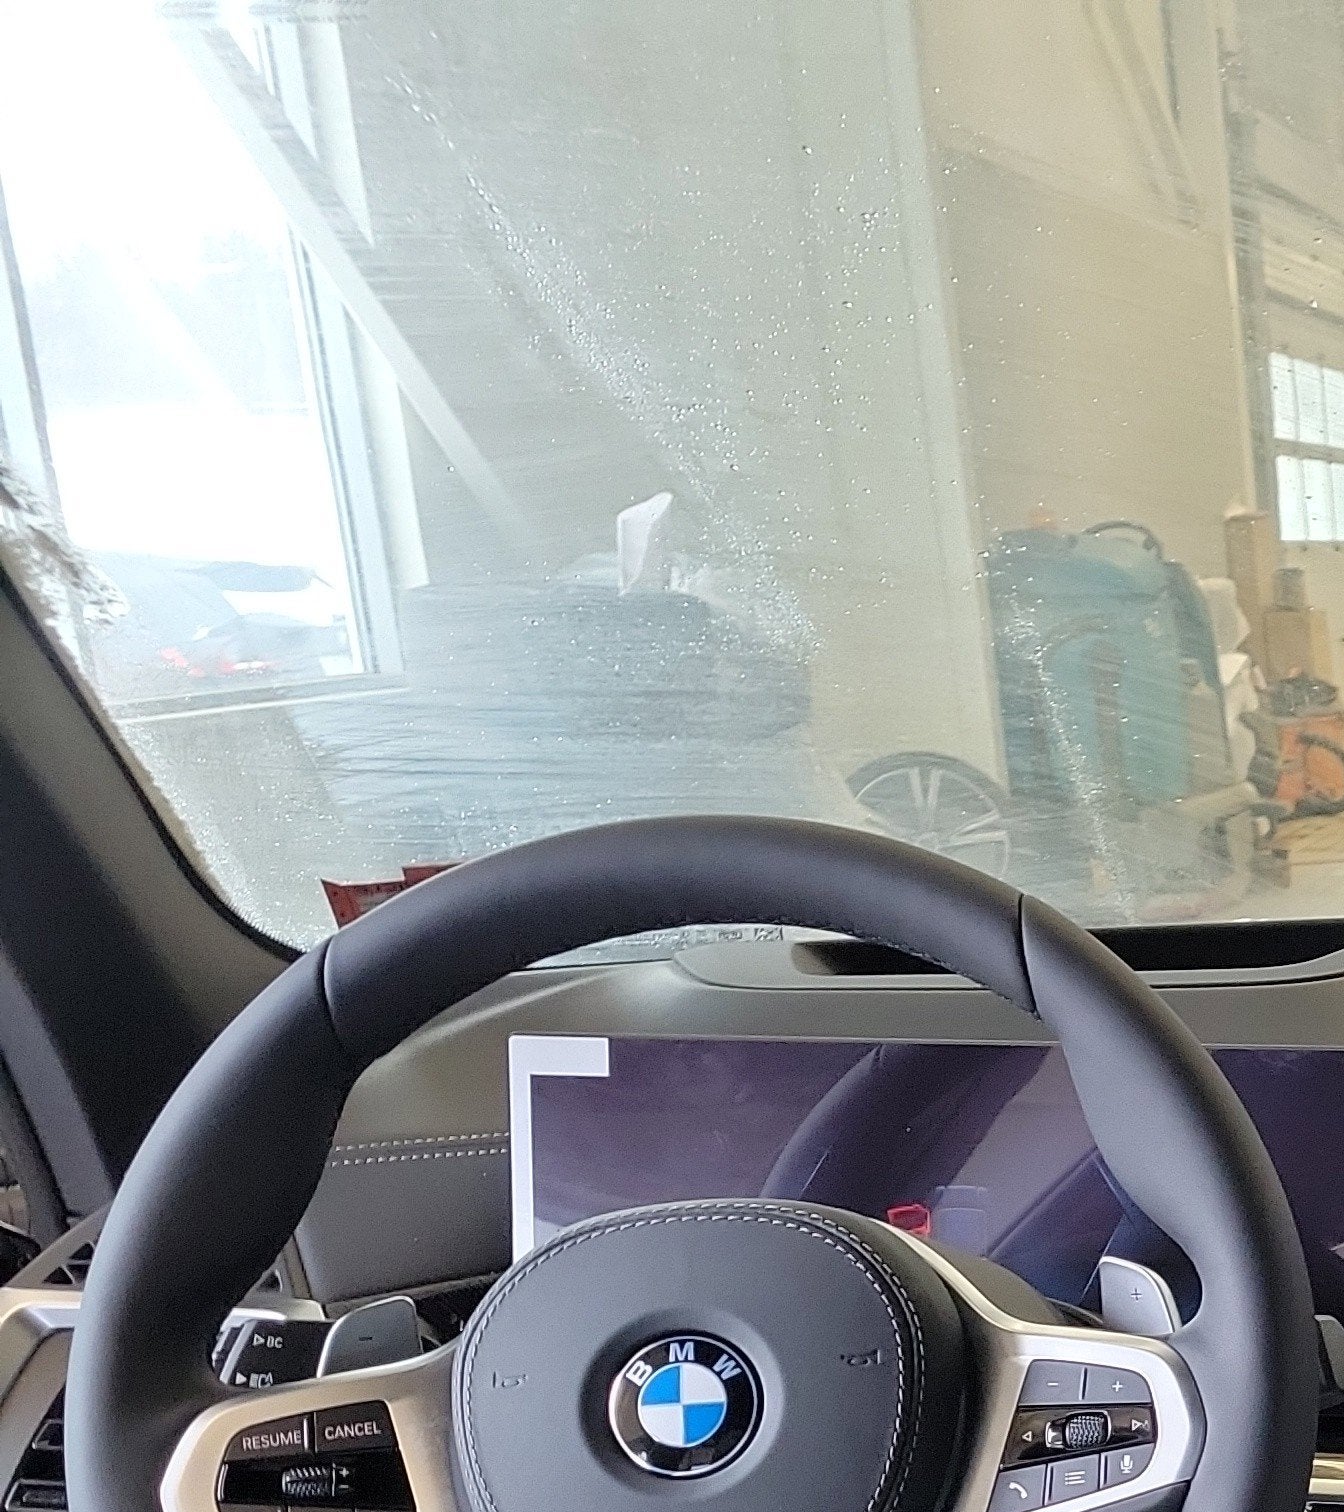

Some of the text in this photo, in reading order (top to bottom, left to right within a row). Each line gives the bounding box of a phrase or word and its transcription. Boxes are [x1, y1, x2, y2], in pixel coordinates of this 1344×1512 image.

[625, 1341, 742, 1387] BMW
[242, 1430, 302, 1450] RESUME
[324, 1421, 382, 1441] CANCEL
